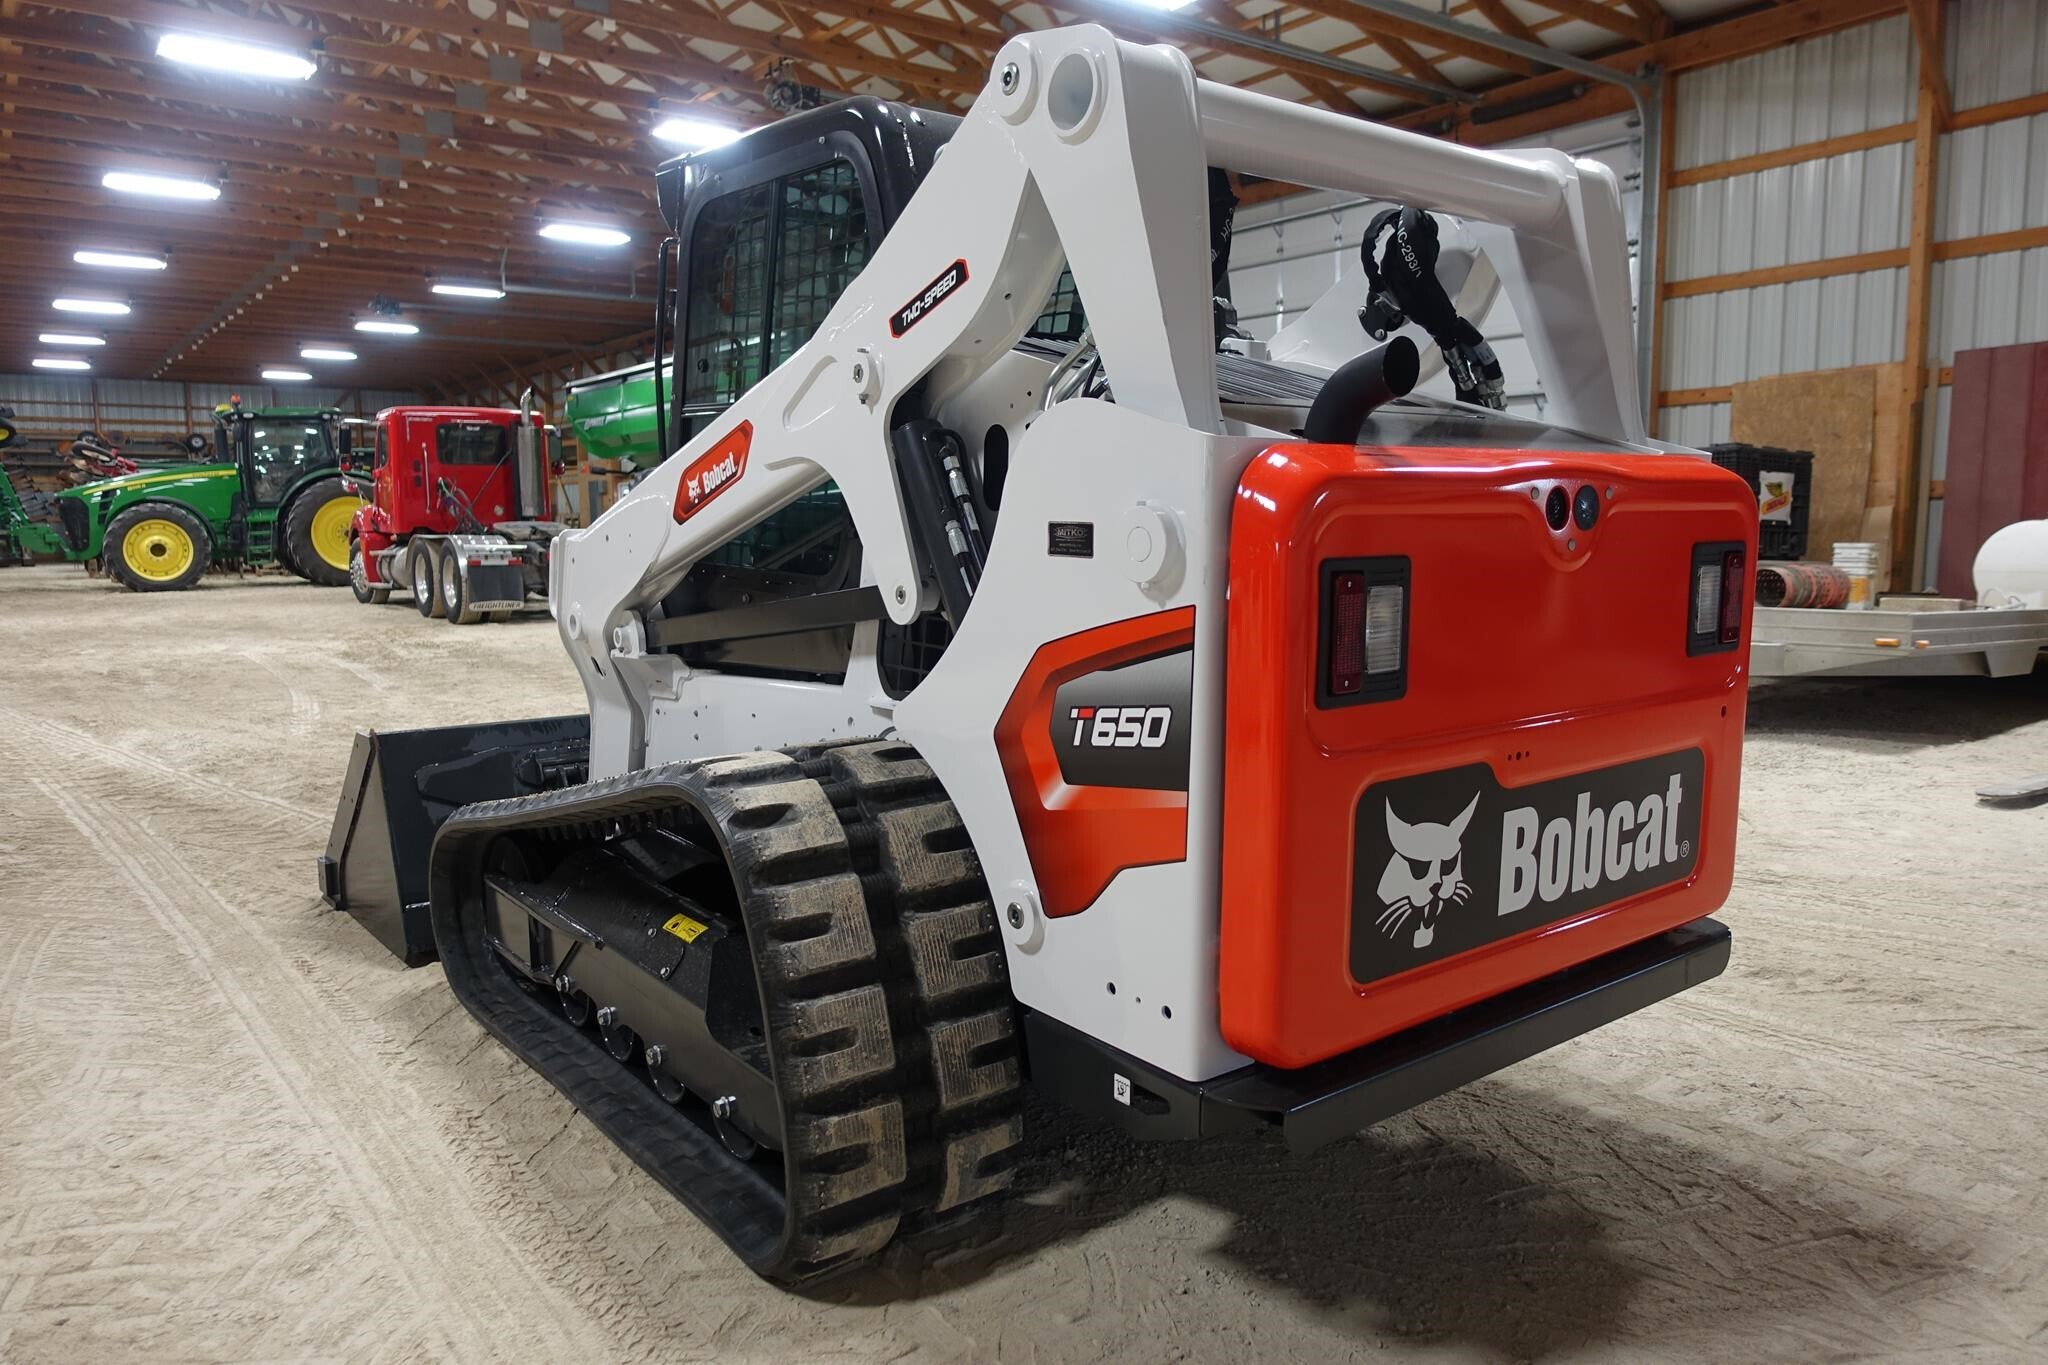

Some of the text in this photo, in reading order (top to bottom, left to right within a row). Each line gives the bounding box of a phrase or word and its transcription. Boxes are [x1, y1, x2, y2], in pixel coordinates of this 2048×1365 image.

[902, 269, 957, 326] TWO-SPEED
[702, 451, 736, 494] Bobcat
[1070, 707, 1172, 748] T650
[1497, 773, 1682, 916] Bobcat
